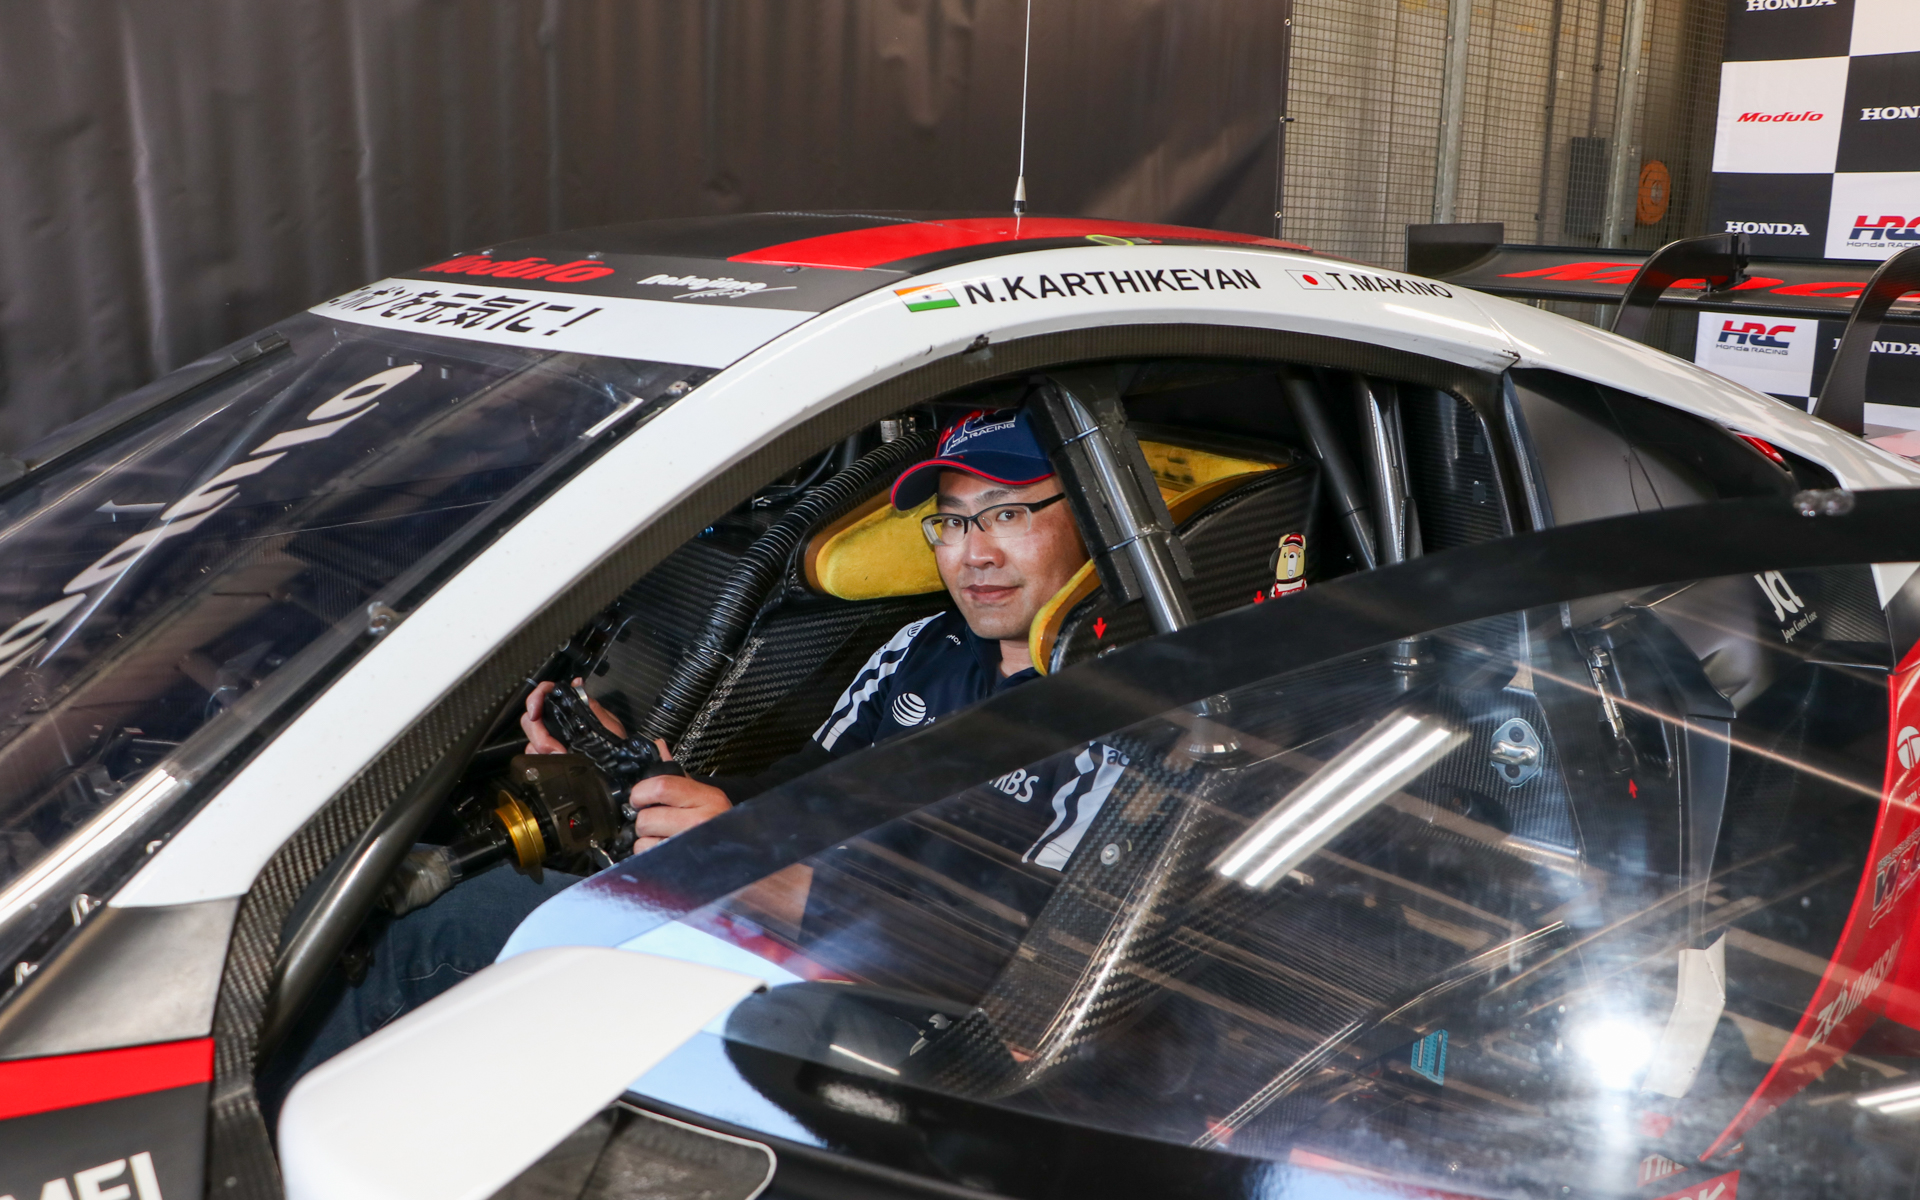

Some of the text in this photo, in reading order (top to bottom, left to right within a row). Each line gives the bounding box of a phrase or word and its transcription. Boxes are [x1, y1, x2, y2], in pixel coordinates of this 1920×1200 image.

[1737, 111, 1824, 123] Modulo
[1725, 221, 1809, 236] HONDA
[962, 269, 1262, 305] N.KARTHIKEYAN
[1325, 272, 1453, 298] T.MAKINO
[1717, 320, 1797, 349] HRC
[1715, 343, 1789, 356] Honda RACING
[1832, 338, 1920, 356] NDA
[969, 421, 1016, 439] RACING
